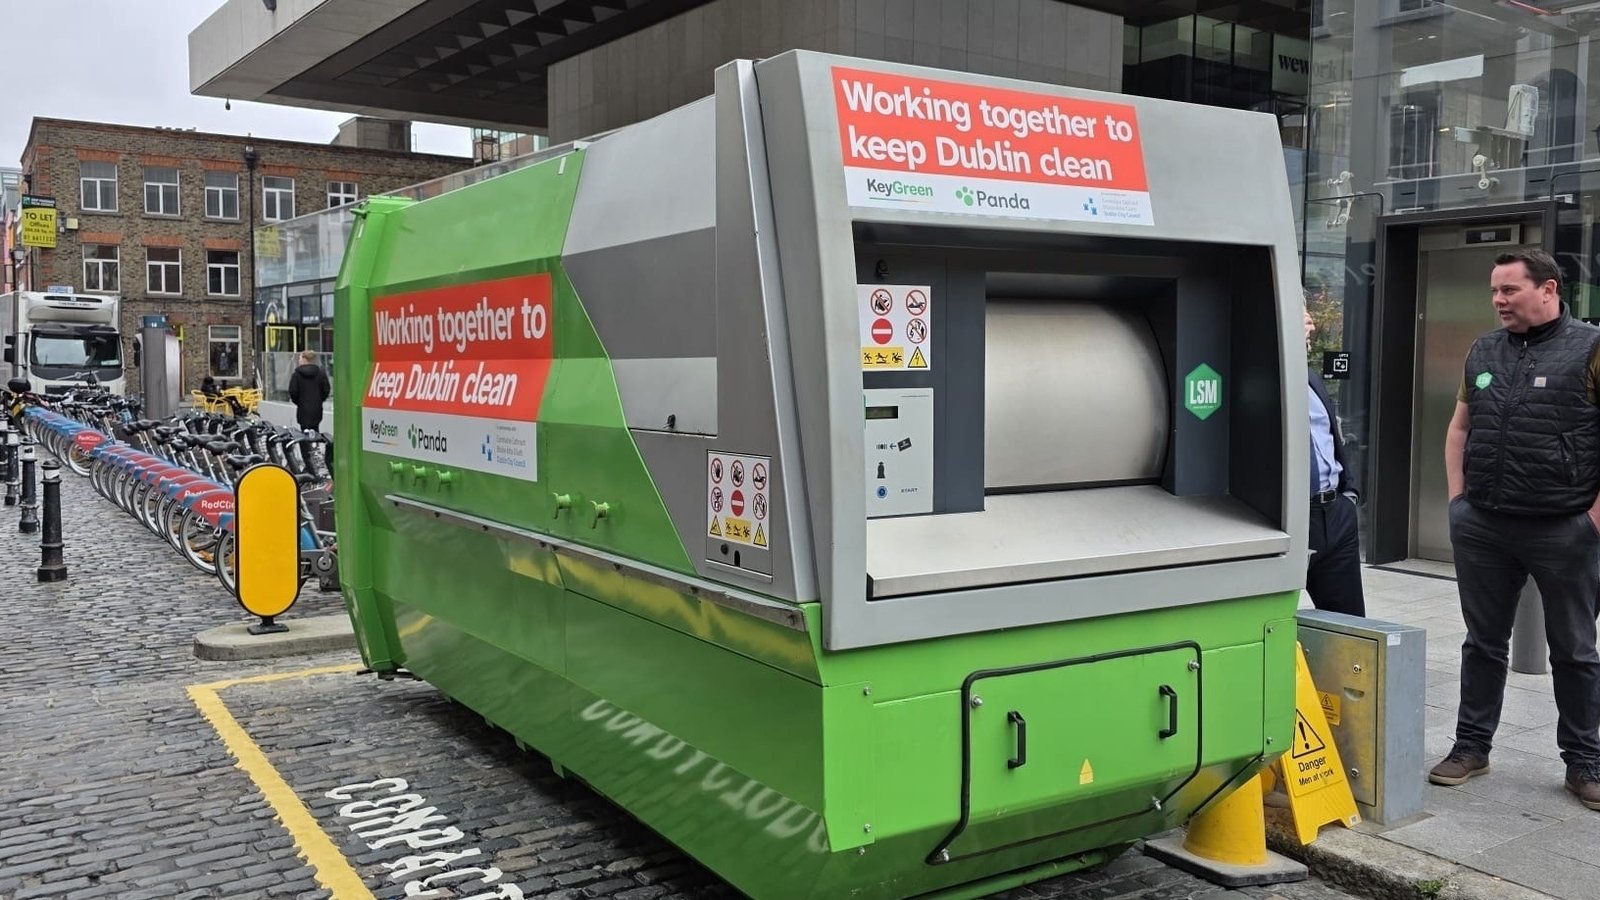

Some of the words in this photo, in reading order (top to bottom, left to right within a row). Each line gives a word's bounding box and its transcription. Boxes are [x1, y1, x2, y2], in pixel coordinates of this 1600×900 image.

[841, 79, 971, 132] Working
[979, 99, 1097, 138] together
[1104, 114, 1133, 142] to
[848, 125, 927, 170] keep
[935, 136, 1031, 174] Dublin
[1039, 147, 1113, 181] clean
[867, 178, 933, 198] KeyGreen
[976, 190, 1030, 210] Panda
[25, 212, 37, 220] TO
[40, 213, 54, 221] LET
[375, 303, 434, 353] Working
[437, 296, 515, 353] together
[521, 297, 547, 339] to
[368, 362, 405, 407] keep
[405, 359, 460, 402] Dublin
[462, 361, 518, 407] clean
[1190, 379, 1217, 404] LSM
[370, 419, 398, 438] KeyGreen
[418, 428, 448, 452] Panda
[1298, 756, 1327, 772] Danger
[1299, 776, 1313, 785] Men
[1313, 773, 1319, 781] at
